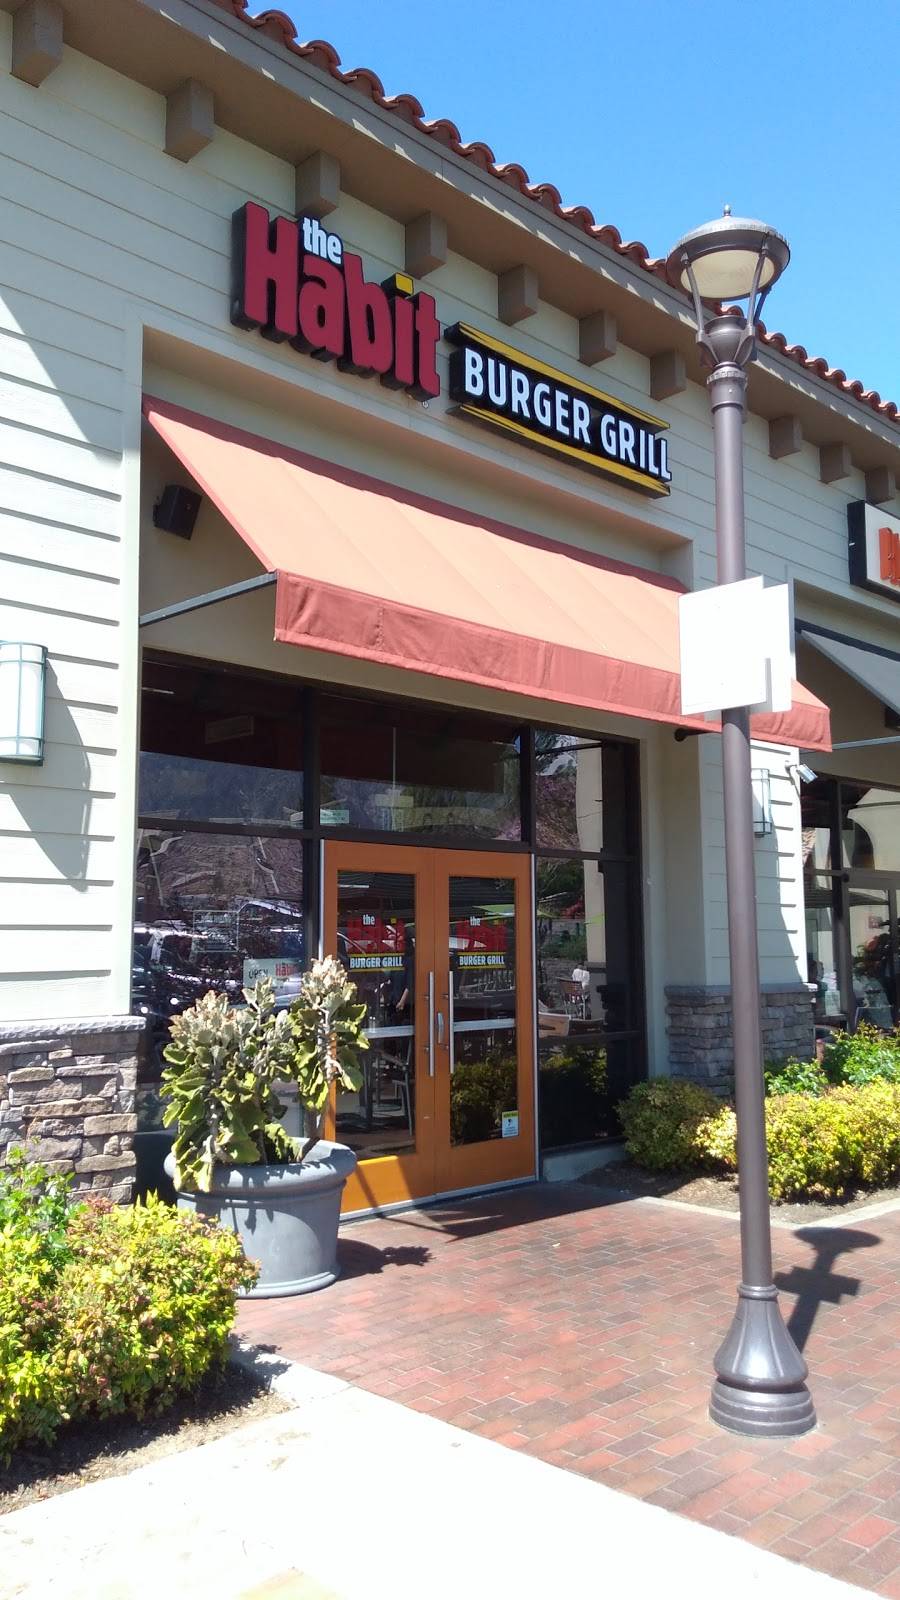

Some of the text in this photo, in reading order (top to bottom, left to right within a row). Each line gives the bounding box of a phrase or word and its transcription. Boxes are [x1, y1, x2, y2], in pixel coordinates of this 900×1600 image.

[302, 217, 342, 264] the
[241, 201, 441, 400] Habit
[464, 346, 672, 482] BURGER GRILL
[362, 914, 375, 926] the
[470, 916, 481, 926] the
[350, 956, 403, 968] BURGER GRILL
[459, 955, 505, 966] BURGER GRILL
